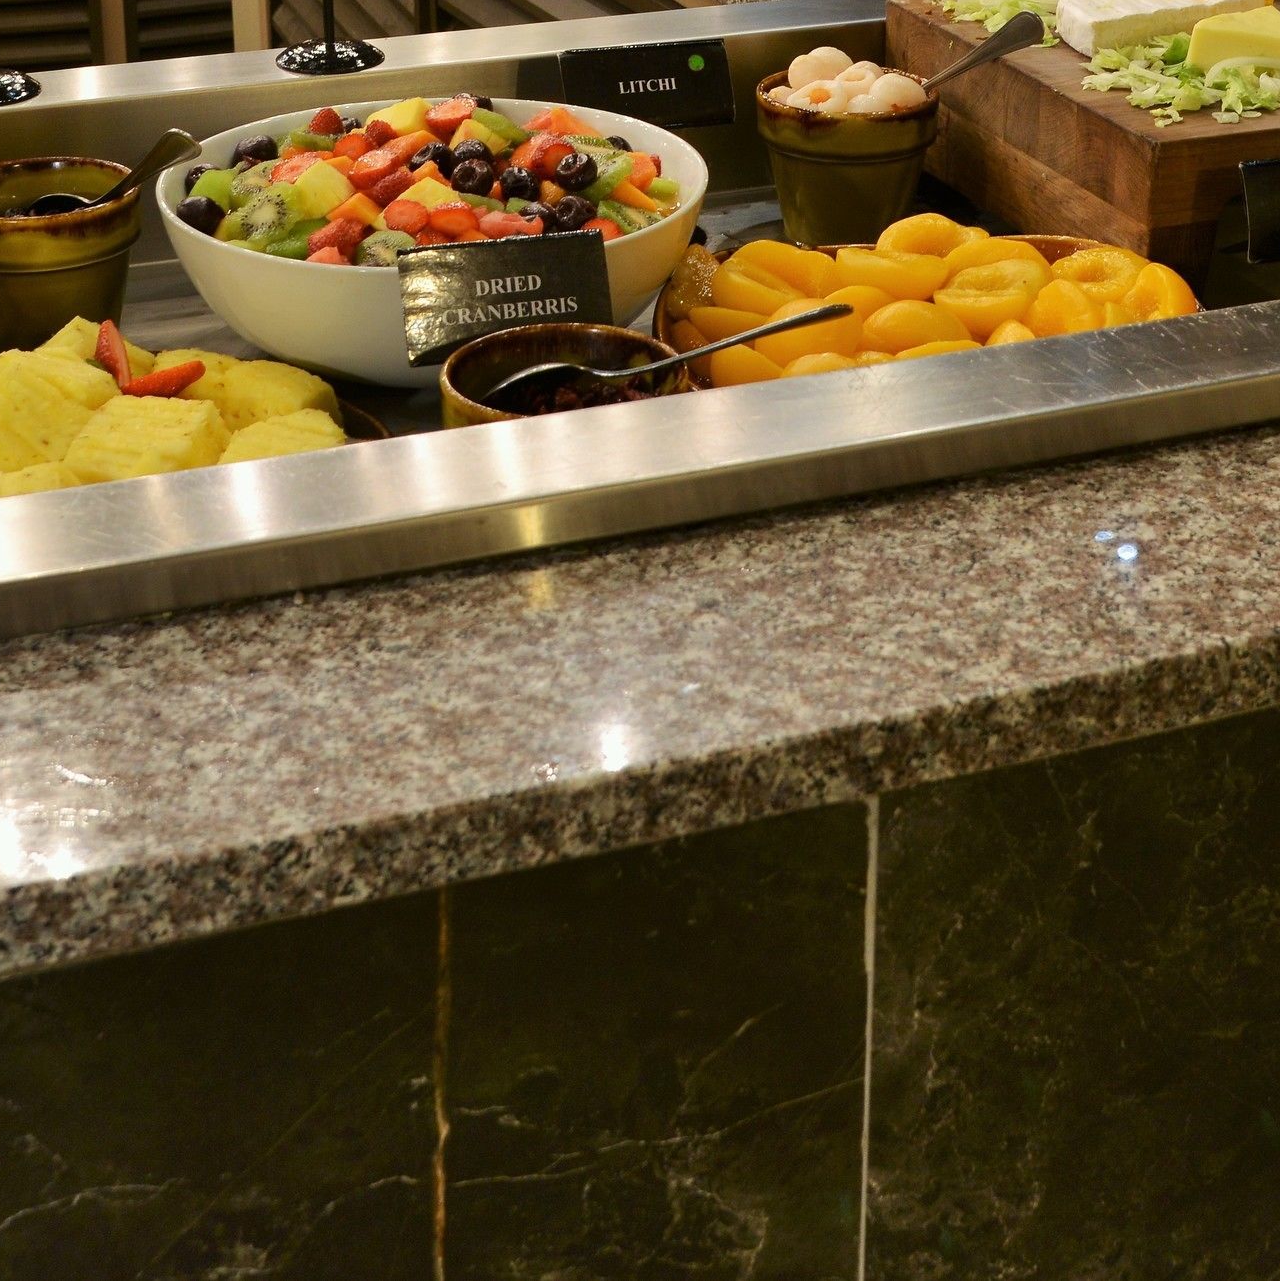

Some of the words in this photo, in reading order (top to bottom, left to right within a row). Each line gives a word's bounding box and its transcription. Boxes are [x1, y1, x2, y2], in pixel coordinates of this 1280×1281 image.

[619, 77, 677, 95] LITCHI
[475, 274, 542, 297] DRIED
[442, 296, 578, 326] CRANBERRIS
